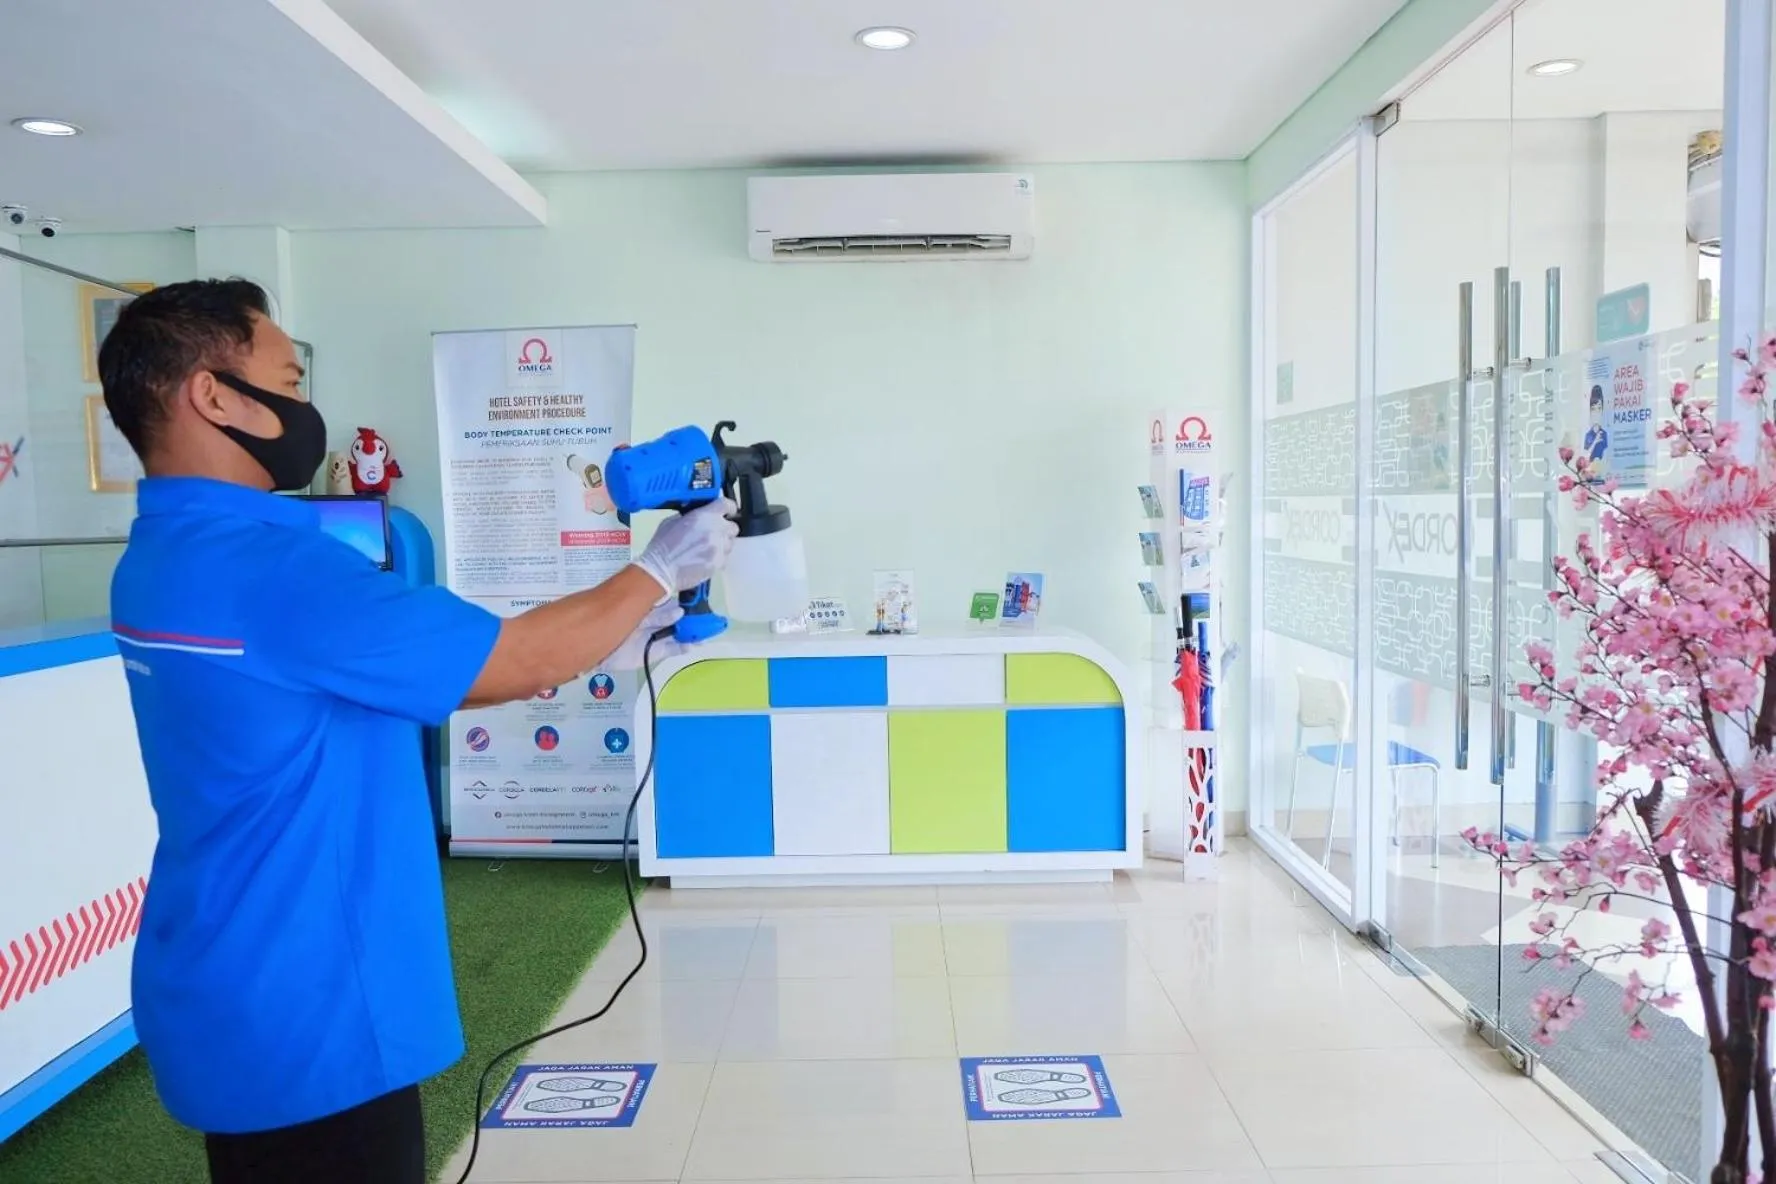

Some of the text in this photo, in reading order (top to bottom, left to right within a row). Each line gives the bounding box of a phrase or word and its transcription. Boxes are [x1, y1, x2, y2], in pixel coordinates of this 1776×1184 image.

[518, 364, 551, 372] OMEGA
[1613, 364, 1639, 381] AREA
[1613, 379, 1644, 395] WAJIB
[489, 397, 513, 408] HOTEL
[513, 396, 542, 407] SAFETY
[550, 393, 584, 405] HEALTHY
[1613, 394, 1642, 408] PAKAI
[488, 407, 587, 421] ENVIRONMENT PROCEDURE
[1613, 408, 1653, 425] MASKER
[464, 426, 613, 439] BODY TEMPERATURE CHECK POINT
